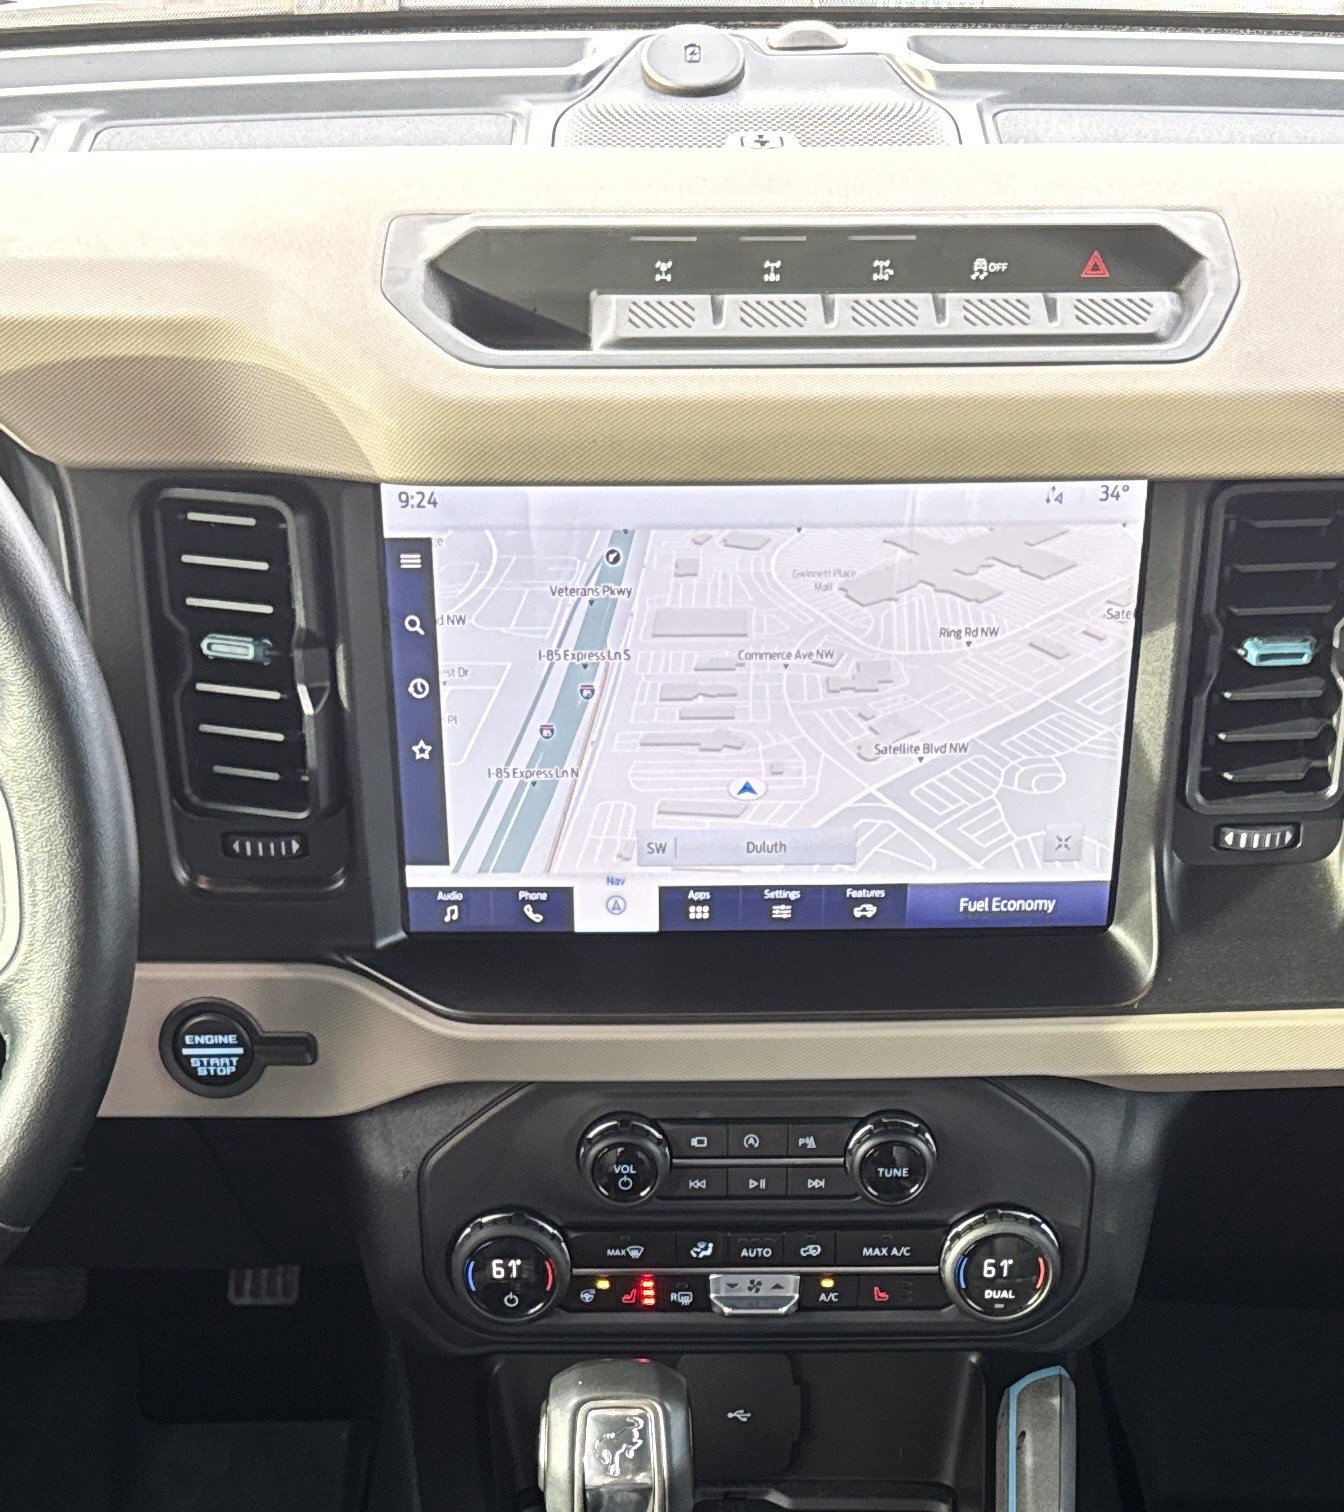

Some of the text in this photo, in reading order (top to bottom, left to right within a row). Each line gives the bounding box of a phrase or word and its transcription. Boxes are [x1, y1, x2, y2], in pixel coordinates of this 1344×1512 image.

[988, 262, 1008, 272] OFF
[1099, 484, 1129, 501] 34°
[398, 492, 438, 509] 9:24
[792, 568, 856, 579] Gwinnett Place
[549, 585, 632, 598] Veterans Pkwy
[814, 581, 833, 592] Mall
[1107, 608, 1132, 619] Sate
[447, 615, 466, 625] NW
[939, 627, 999, 641] Ring Rd NW
[538, 650, 631, 662] I-85 Express Ln S
[738, 649, 834, 661] Commerce Ave NW
[458, 667, 469, 677] Dr
[874, 743, 969, 755] Satellite Blvd NW
[488, 768, 579, 781] I-85 Express Ln N
[646, 841, 787, 854] SW Duluth
[606, 876, 626, 886] Nav
[437, 891, 463, 901] Audio
[518, 890, 547, 901] Phone
[688, 890, 711, 902] Apps
[763, 888, 801, 900] Settings
[846, 888, 885, 898] Features
[959, 898, 1056, 914] Fuel Economy
[185, 1034, 238, 1045] ENGINE
[190, 1057, 239, 1067] START
[197, 1066, 236, 1076] STOP
[613, 1165, 636, 1174] VOL
[877, 1167, 909, 1178] TUNE
[607, 1248, 626, 1257] MAX
[740, 1248, 772, 1258] AUTO
[863, 1246, 911, 1257] MAX A/C
[670, 1292, 678, 1302] R
[819, 1292, 839, 1302] A/C
[984, 1290, 1015, 1299] DUAL
